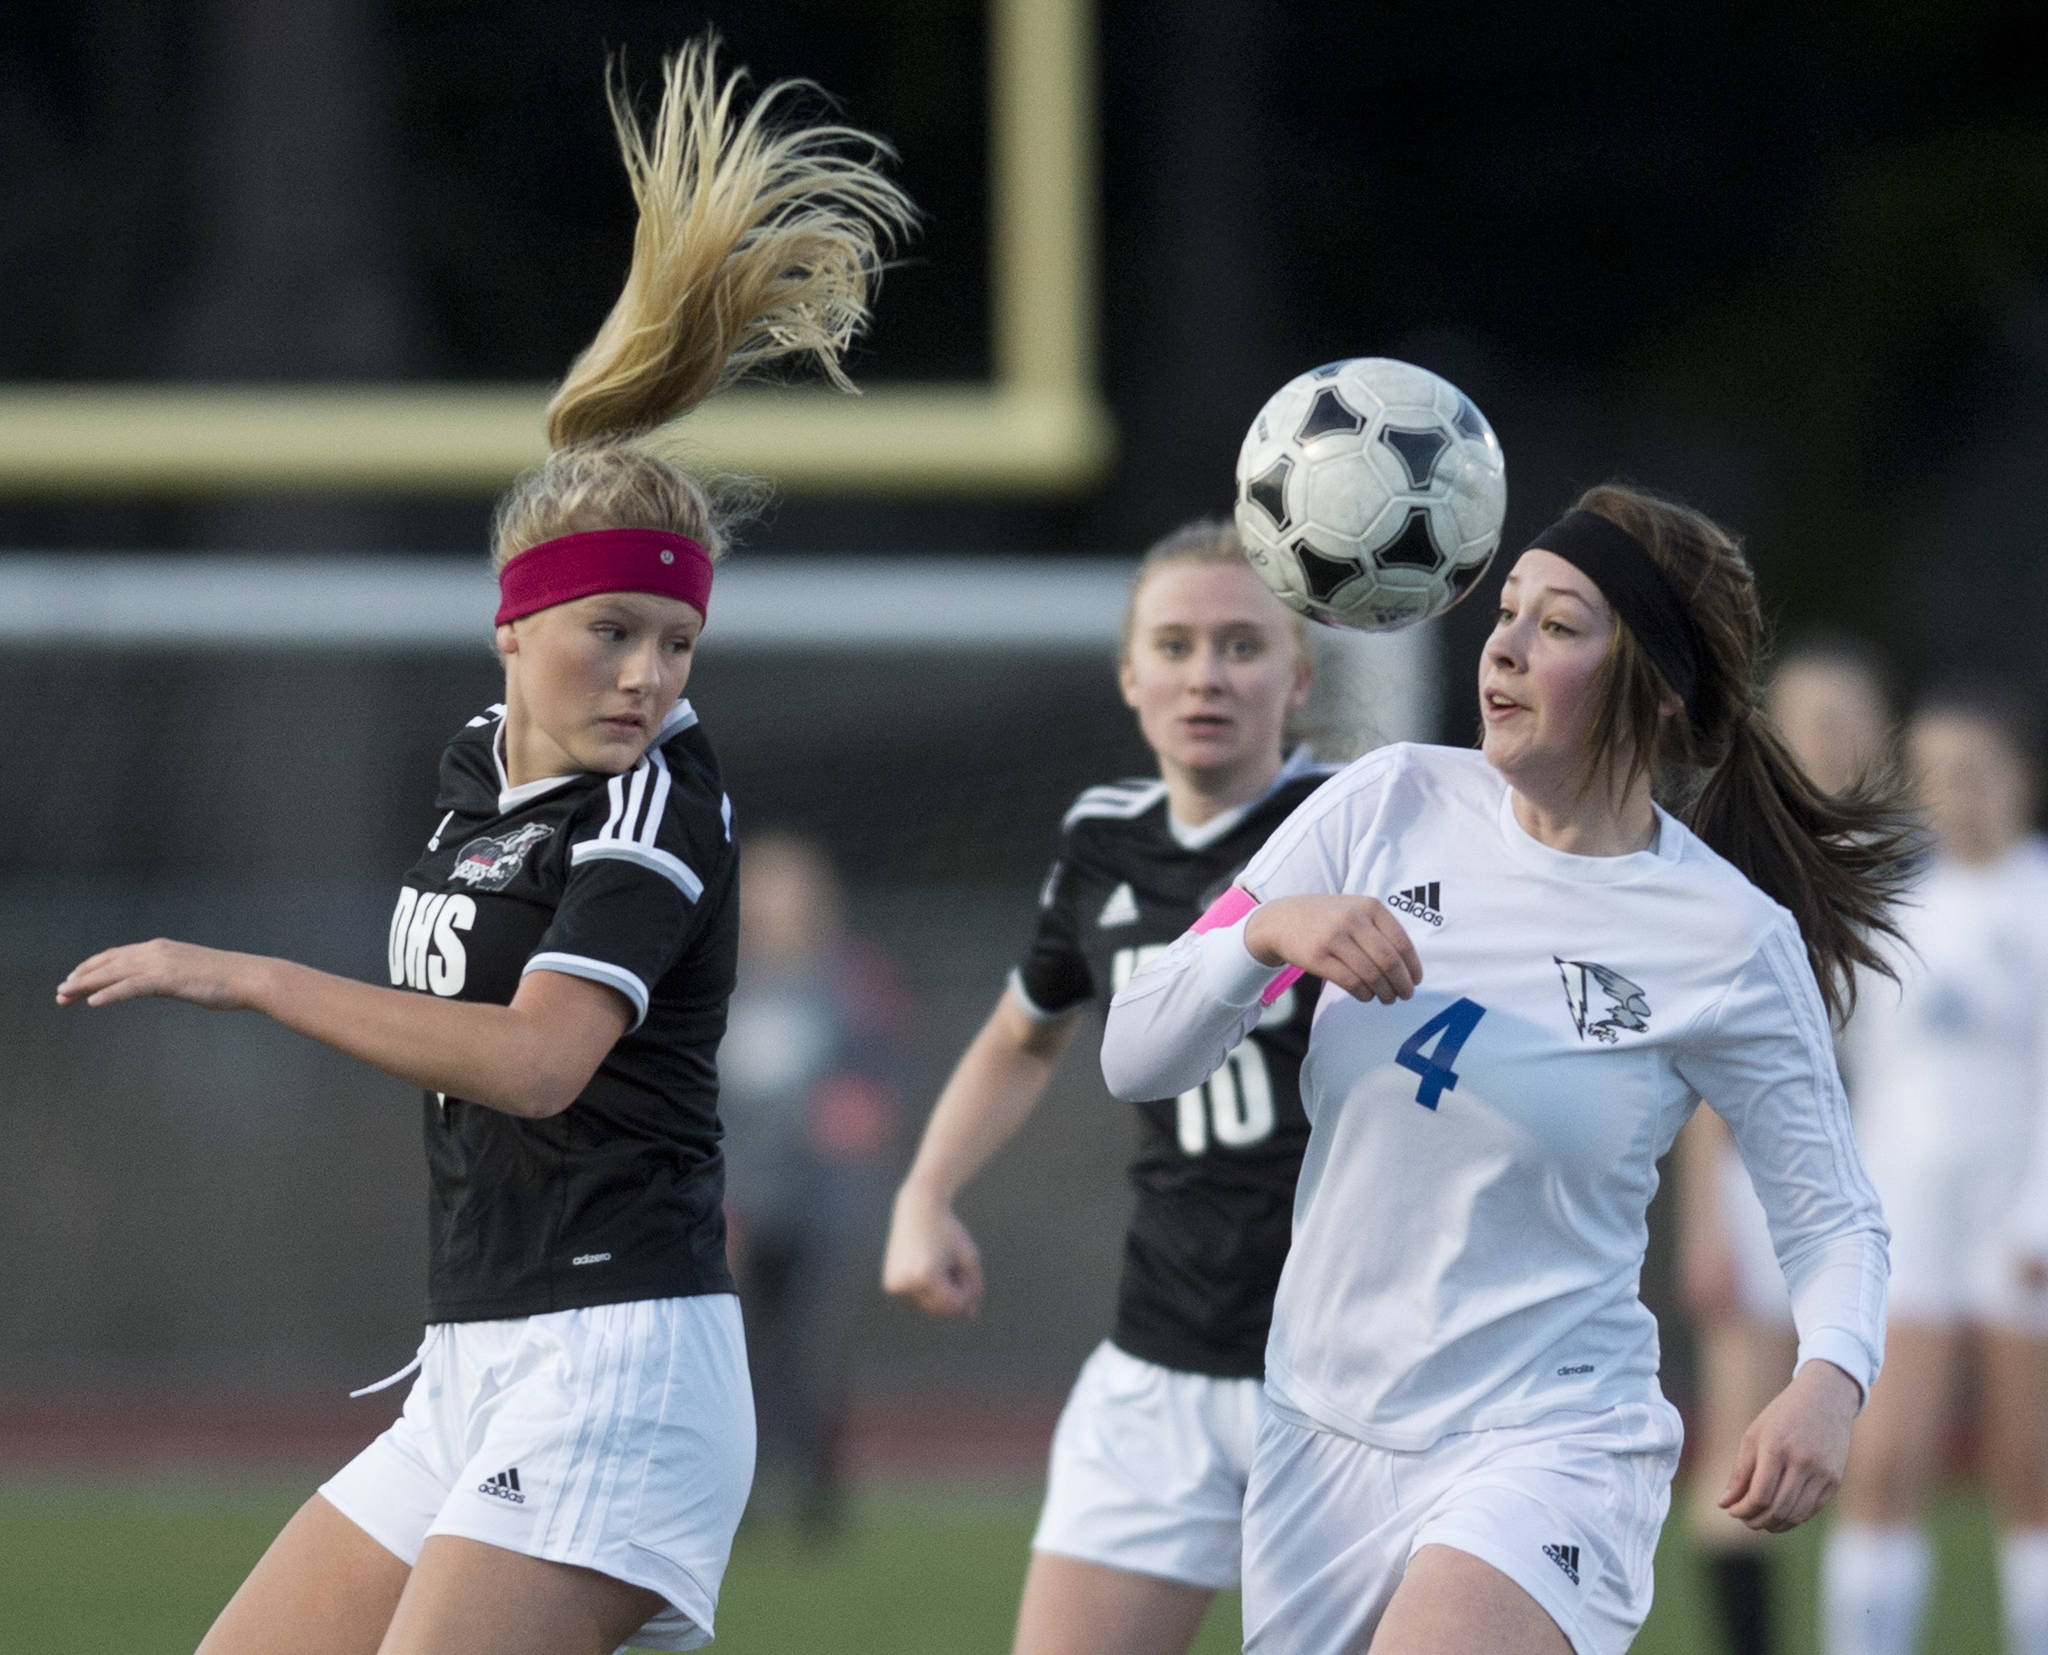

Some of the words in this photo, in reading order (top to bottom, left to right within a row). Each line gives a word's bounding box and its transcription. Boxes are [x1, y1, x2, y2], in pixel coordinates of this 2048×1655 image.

[1387, 895, 1444, 927] adidas
[388, 886, 476, 997] DHS
[1395, 997, 1487, 1111] 4
[572, 1252, 612, 1266] adizero
[478, 1483, 526, 1504] adidas
[1541, 1545, 1580, 1586] adidas
